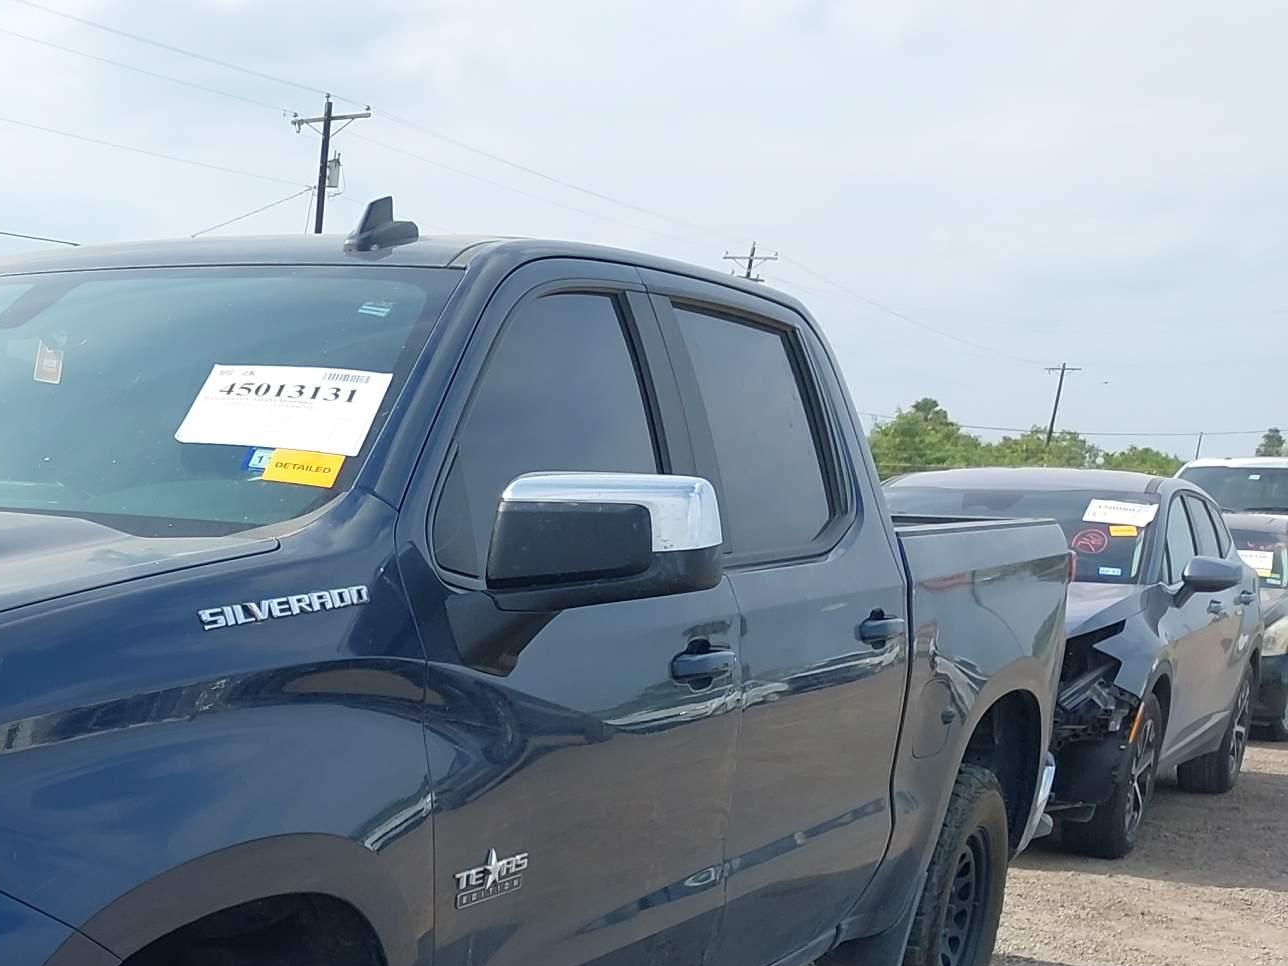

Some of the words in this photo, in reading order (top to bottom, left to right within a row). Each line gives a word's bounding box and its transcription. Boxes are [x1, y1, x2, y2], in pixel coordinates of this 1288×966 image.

[218, 381, 358, 404] 45013131
[275, 461, 332, 474] DETAILED
[198, 585, 370, 631] SILVERADO
[462, 879, 519, 904] EDITION
